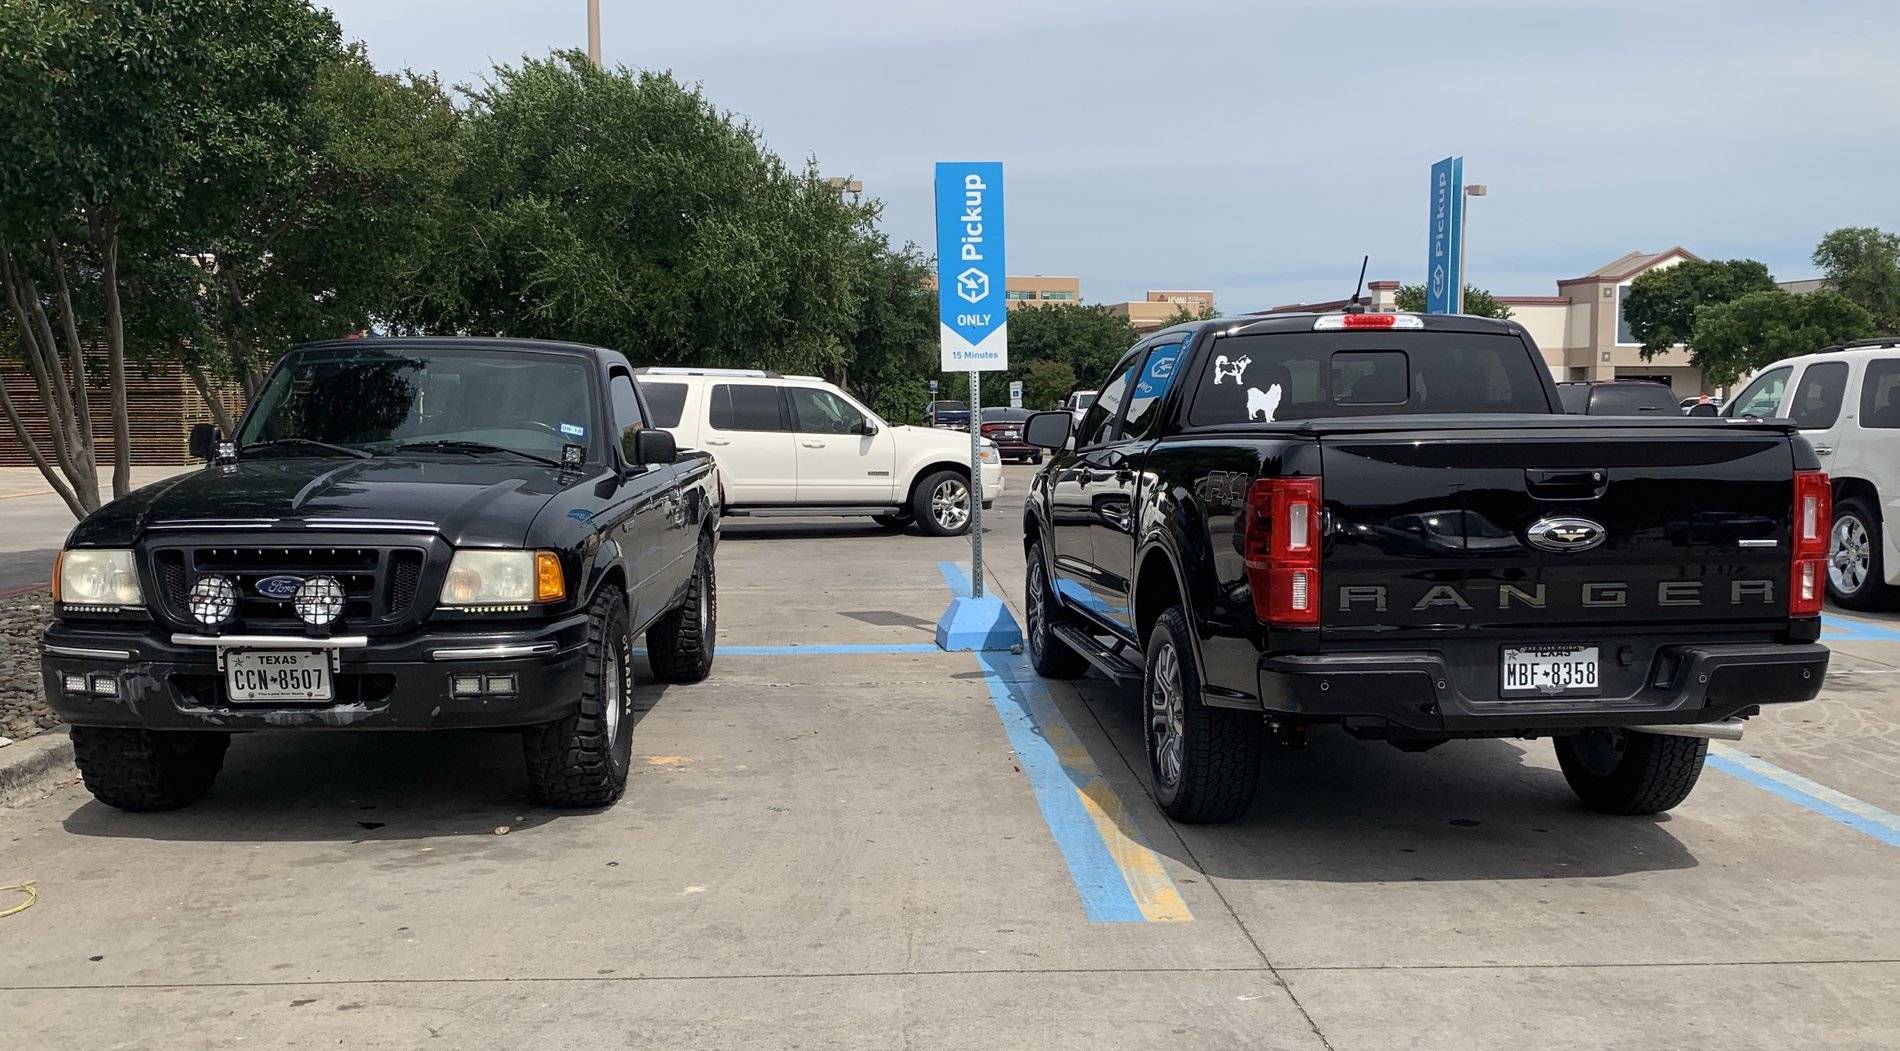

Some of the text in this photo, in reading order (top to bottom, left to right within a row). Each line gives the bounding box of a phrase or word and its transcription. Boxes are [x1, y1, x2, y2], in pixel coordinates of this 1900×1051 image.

[961, 174, 987, 261] Pickup
[1436, 172, 1447, 257] Pickup
[957, 314, 991, 326] ONLY
[952, 351, 999, 360] 15 Minutes
[1205, 470, 1248, 501] FX4
[268, 580, 297, 593] Ford
[1339, 580, 1775, 611] RANGER
[258, 655, 297, 665] TEXAS
[624, 654, 632, 715] RADIAL
